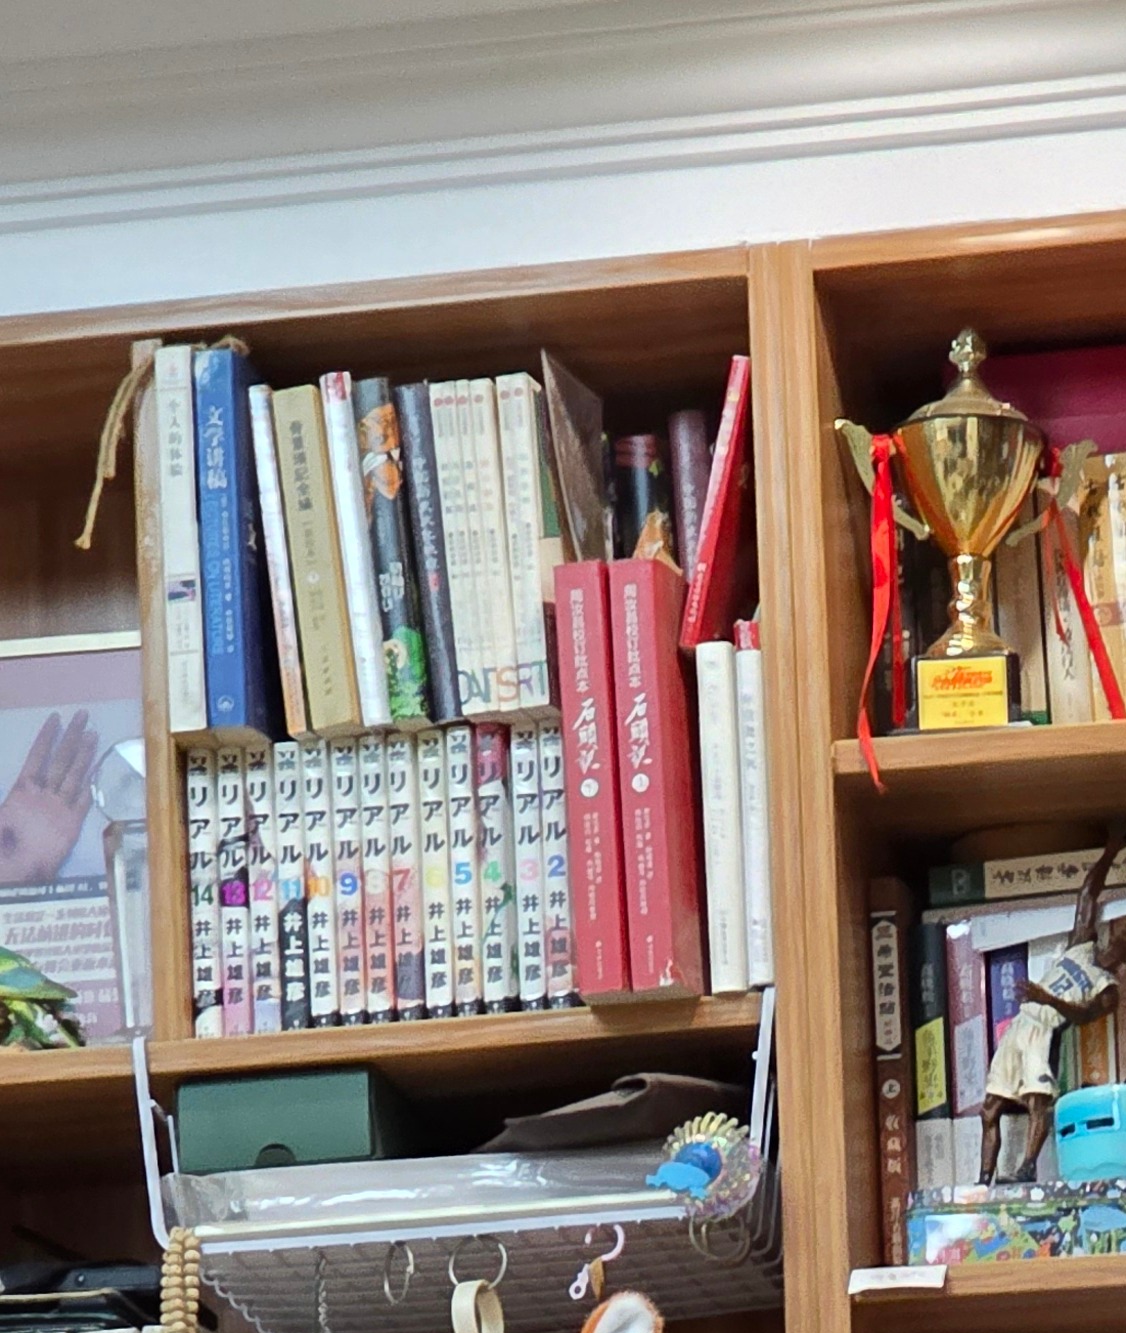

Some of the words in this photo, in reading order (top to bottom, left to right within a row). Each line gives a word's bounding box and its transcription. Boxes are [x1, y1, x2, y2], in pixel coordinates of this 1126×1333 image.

[189, 784, 211, 871] リアル
[220, 783, 244, 868] リアル
[249, 781, 270, 866] リアル
[279, 779, 301, 864] リアル
[306, 777, 328, 862] リアル
[335, 775, 359, 861] リアル
[363, 773, 387, 857] リアル
[389, 770, 412, 855] リアル
[423, 768, 445, 853] リアル
[451, 763, 473, 848] リアル
[479, 761, 502, 847] リアル
[517, 760, 540, 845] リアル
[542, 755, 567, 842] リアル
[192, 884, 213, 906] 14
[223, 881, 246, 904] 13
[252, 877, 273, 902] 12
[280, 878, 301, 899] 11
[308, 876, 331, 898] 10
[339, 871, 359, 895] 9
[394, 868, 411, 893] 7
[426, 863, 444, 888] 6
[455, 861, 472, 885] 5
[483, 860, 501, 883] 4
[520, 858, 539, 882] 3
[548, 855, 565, 877] 2
